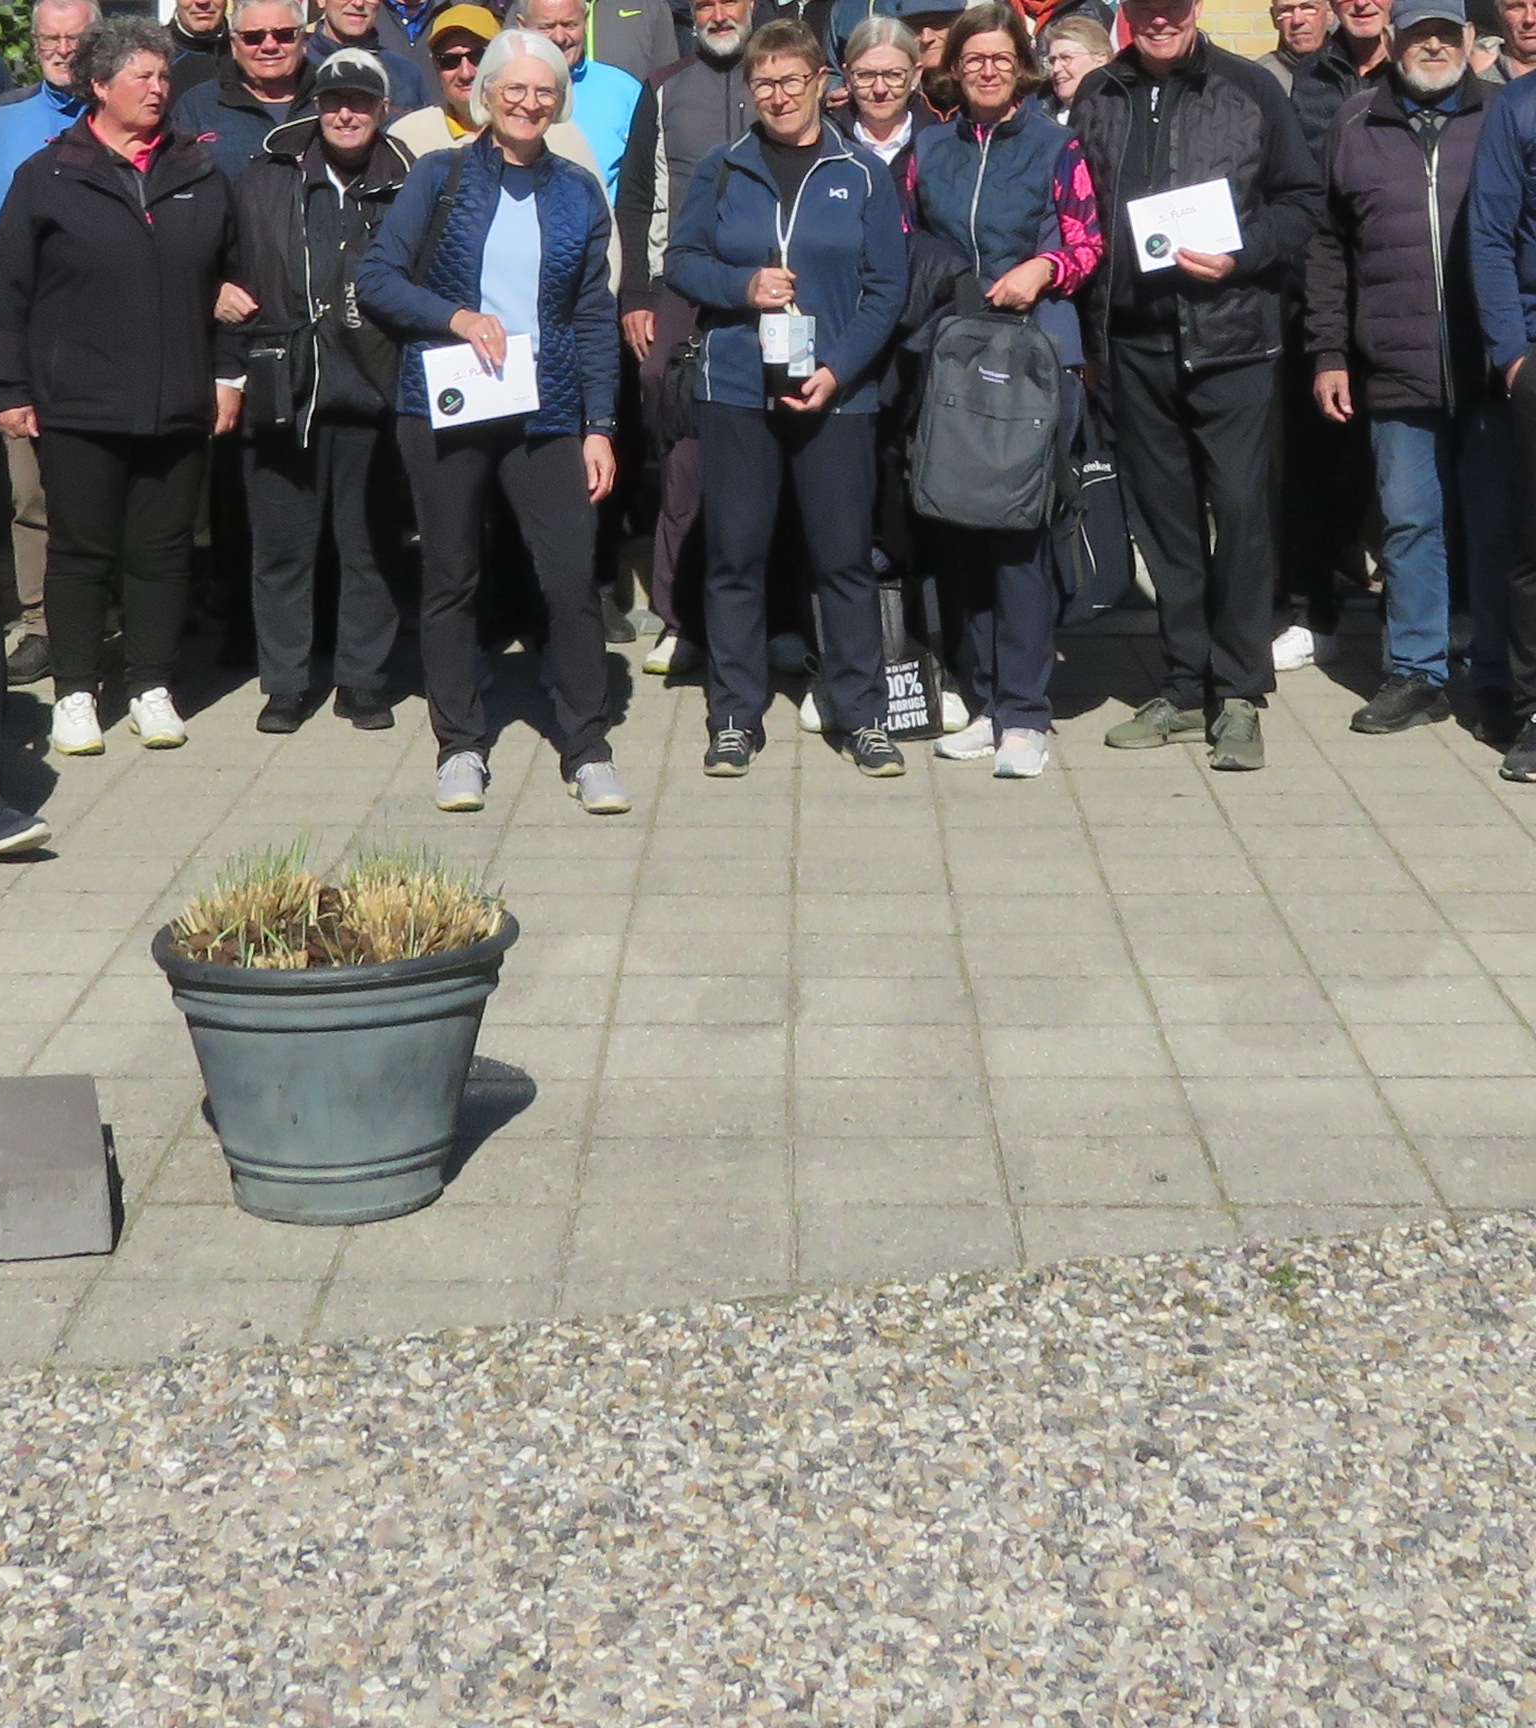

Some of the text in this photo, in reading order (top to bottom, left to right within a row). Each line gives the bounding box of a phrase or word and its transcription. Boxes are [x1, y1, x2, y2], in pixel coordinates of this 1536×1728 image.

[886, 671, 923, 699] 00%
[887, 695, 926, 714] NBRUGS
[886, 709, 929, 731] LASTIK
